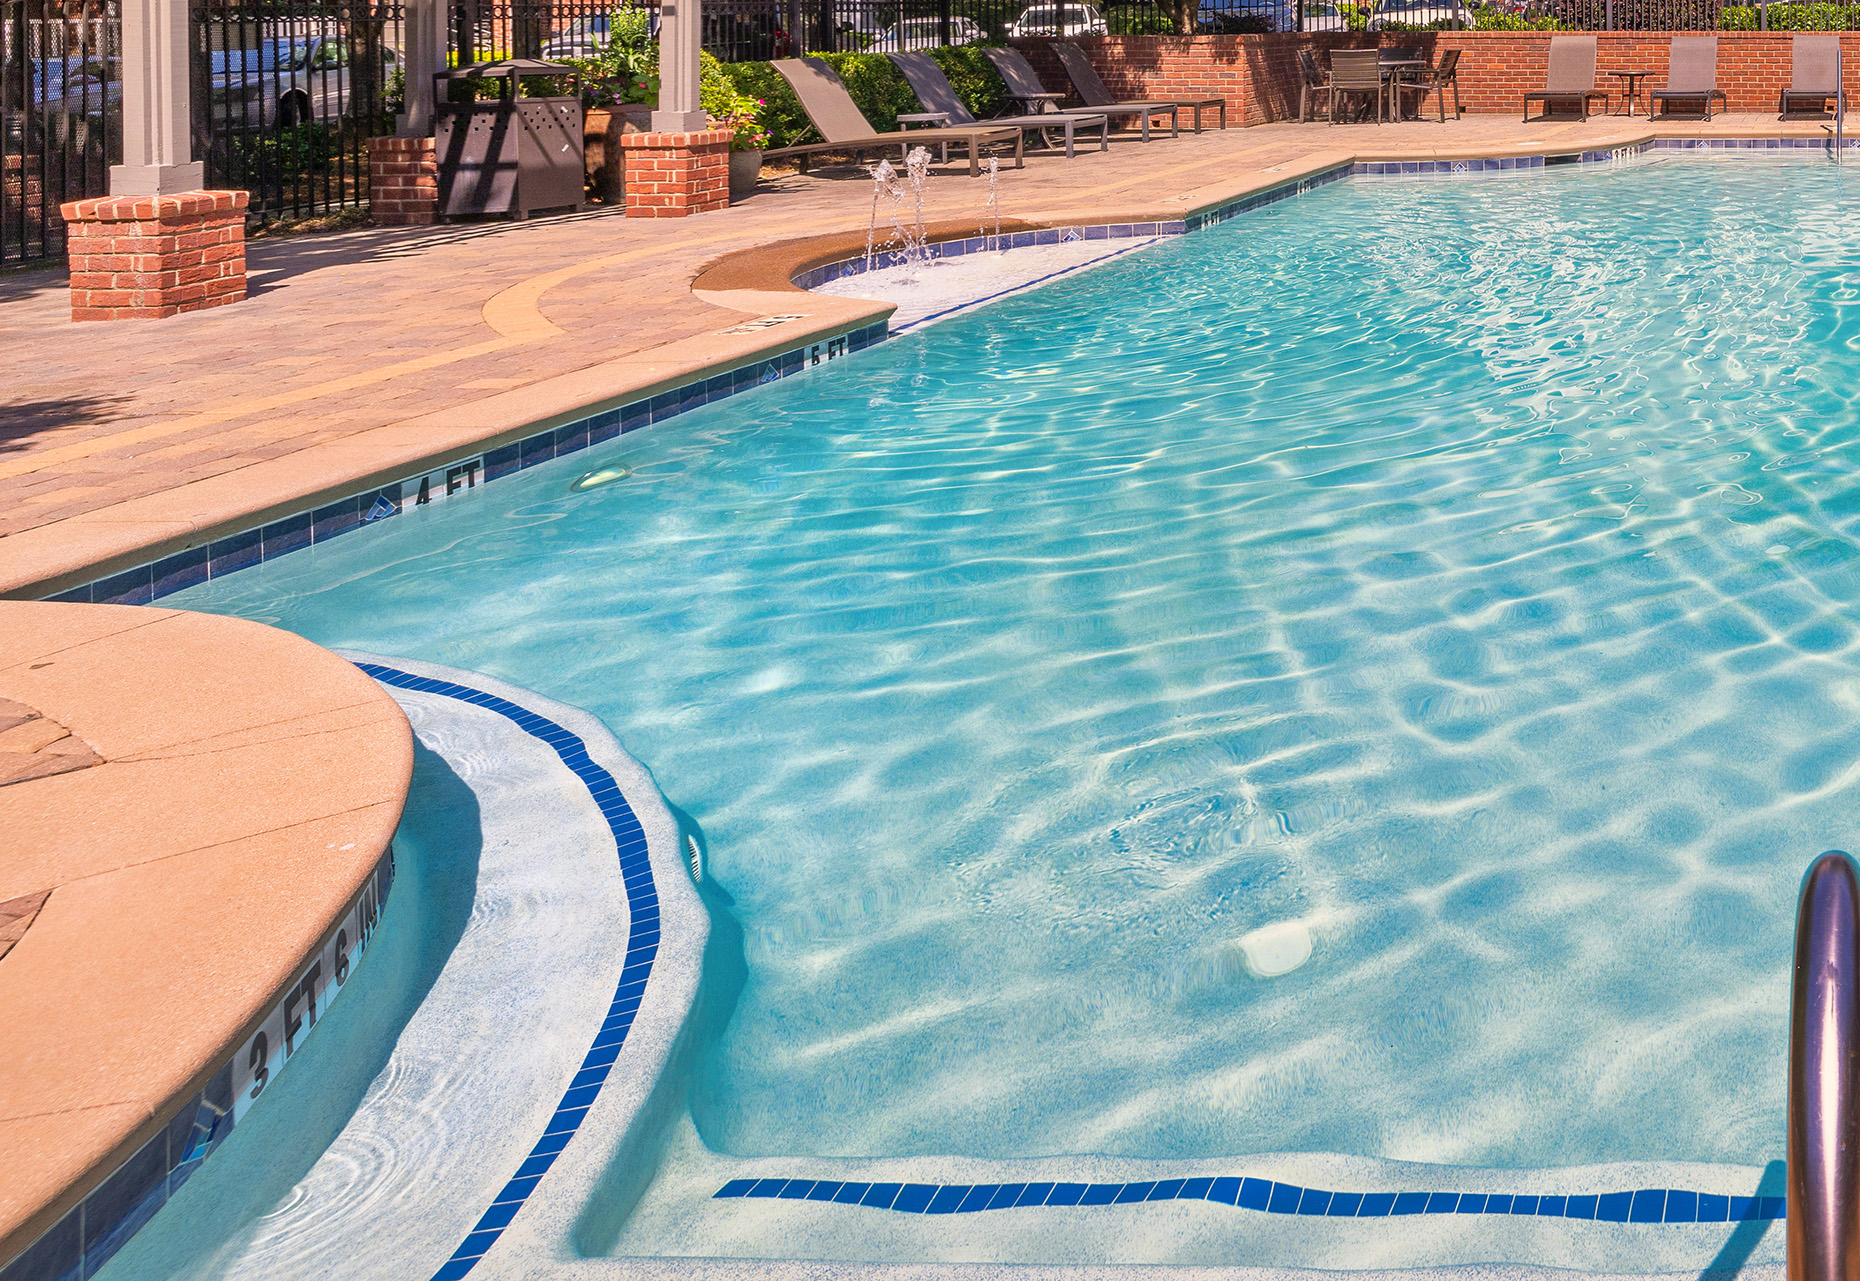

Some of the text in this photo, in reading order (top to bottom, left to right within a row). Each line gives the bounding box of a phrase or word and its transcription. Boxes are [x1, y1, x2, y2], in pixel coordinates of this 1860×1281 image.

[811, 335, 846, 367] 5 FT
[415, 459, 481, 506] 4 FT
[249, 875, 378, 1101] 3 FT 6 IN
